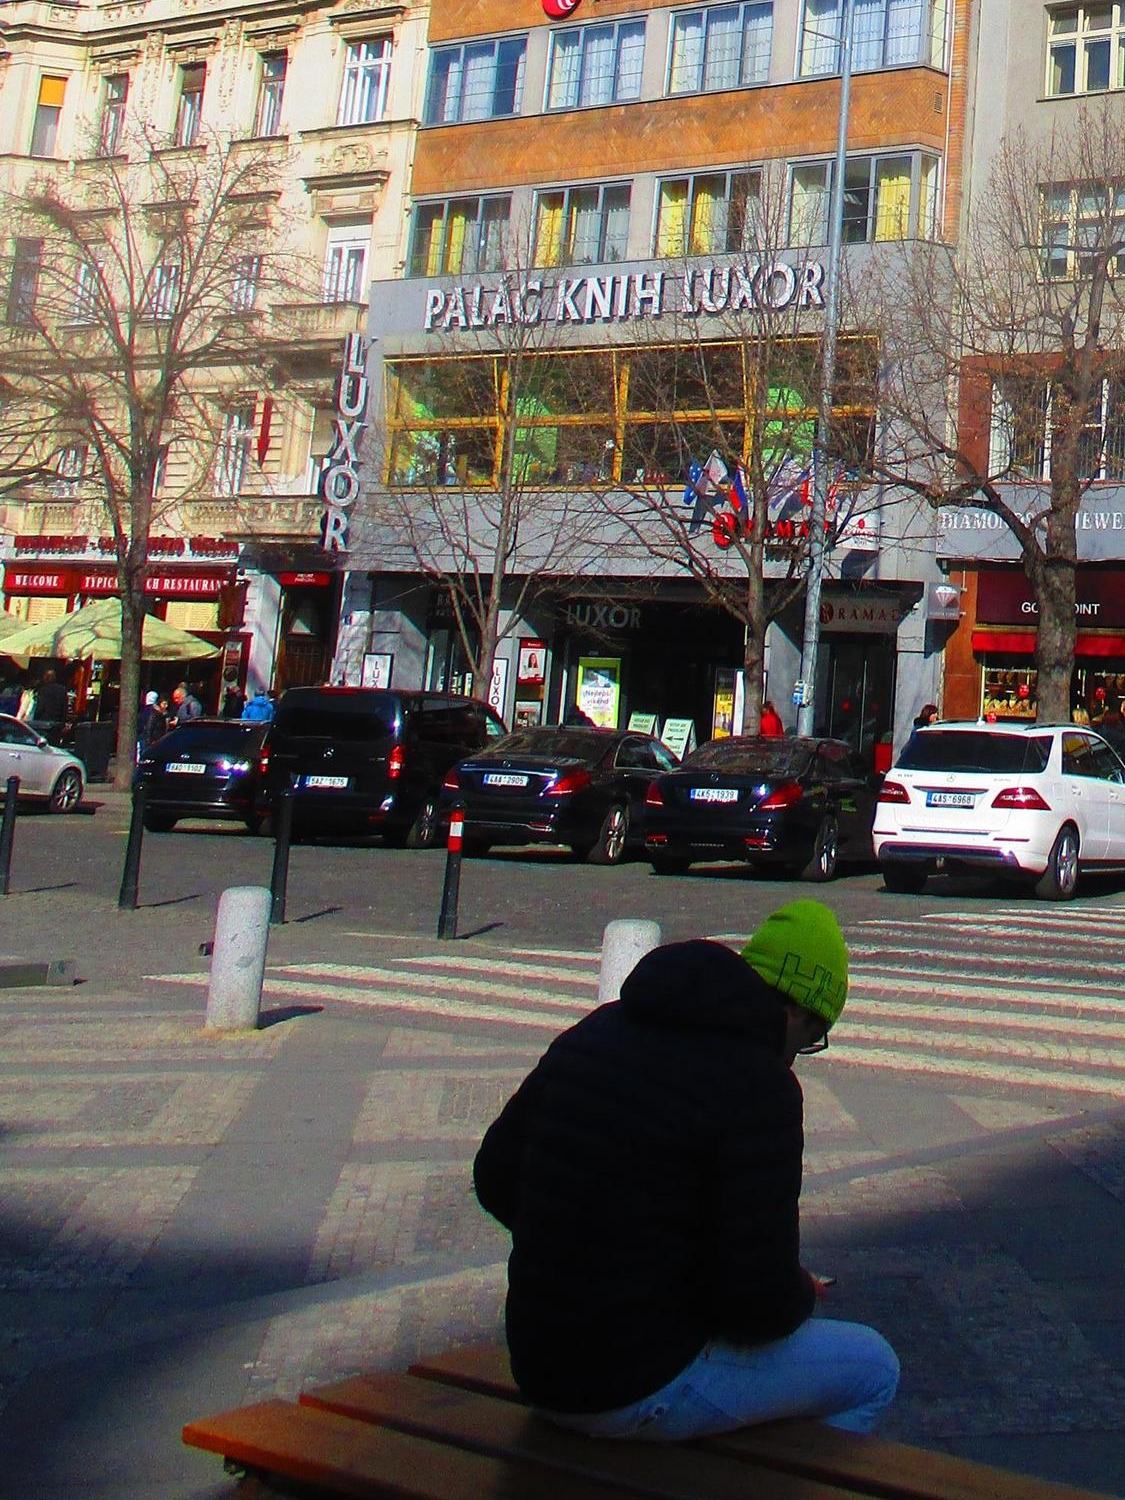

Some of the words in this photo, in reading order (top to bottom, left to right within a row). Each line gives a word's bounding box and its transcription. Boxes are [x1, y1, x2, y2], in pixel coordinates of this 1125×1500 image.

[557, 272, 664, 322] KNIH
[682, 261, 824, 313] LUXOR
[322, 332, 366, 551] LUXOR
[15, 574, 59, 587] WELCOME
[566, 604, 641, 628] LUXOR
